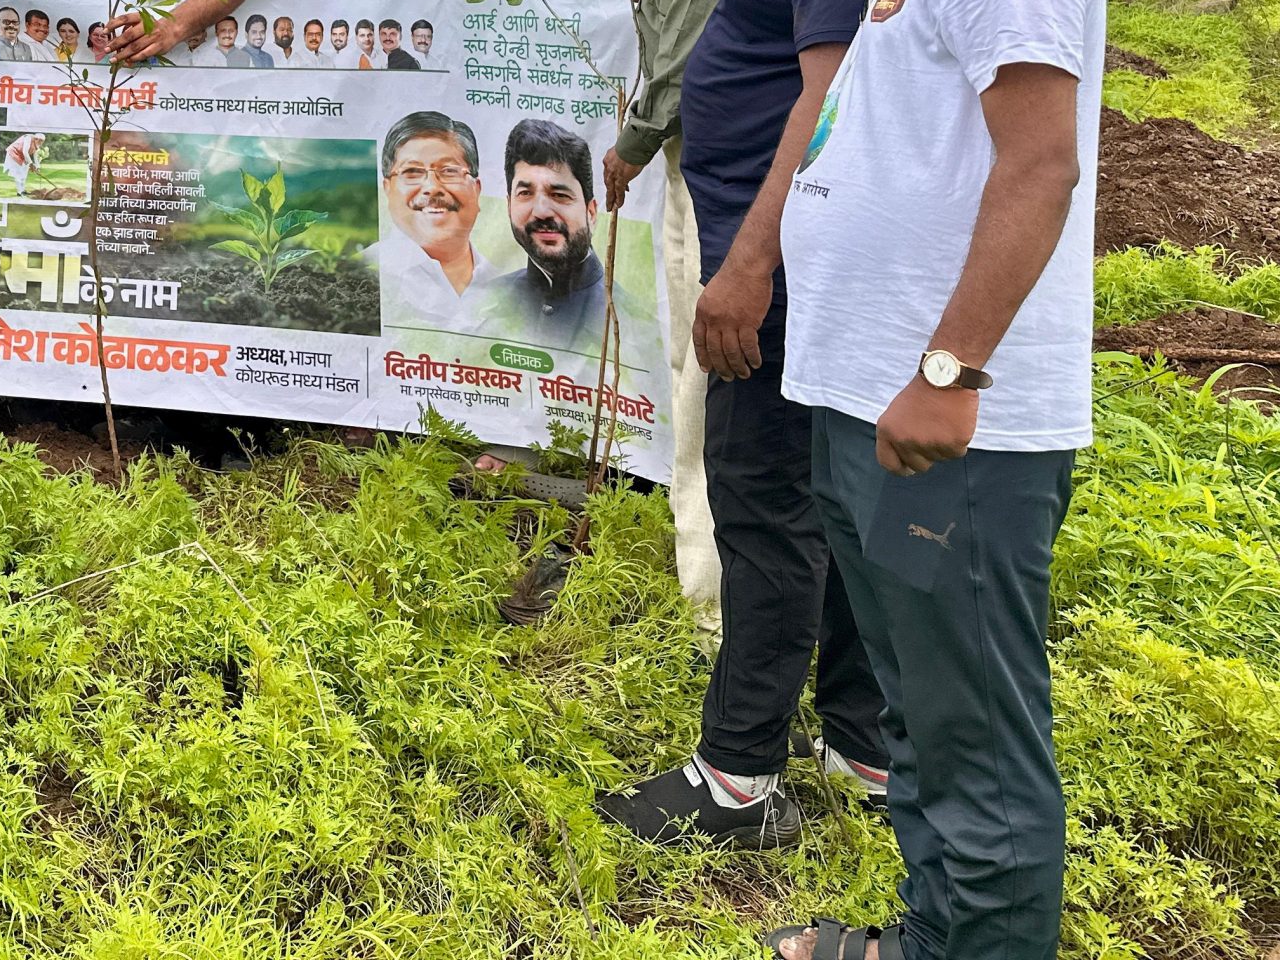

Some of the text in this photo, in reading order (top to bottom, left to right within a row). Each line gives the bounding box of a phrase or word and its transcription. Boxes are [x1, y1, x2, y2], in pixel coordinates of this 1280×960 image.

[463, 9, 498, 33] आई
[503, 9, 539, 33] आणि
[493, 34, 530, 59] दोन्ही
[527, 64, 574, 89] संवर्धन
[37, 85, 104, 109] जनता
[106, 81, 158, 110] पार्टी
[159, 93, 345, 117] कोथरूड मध्य मंडल आयोजित
[517, 93, 565, 114] लागवड
[132, 166, 150, 180] प्रेम,
[151, 170, 173, 182] माया,
[175, 169, 200, 182] आणि
[144, 182, 174, 196] पहिली
[174, 184, 207, 198] सावली.
[119, 196, 145, 210] तिच्या
[146, 198, 196, 213] आठवणींना
[96, 212, 113, 222] एक
[114, 211, 136, 224] हरित
[137, 214, 155, 225] रूप
[96, 226, 112, 237] एक
[113, 227, 134, 240] झाड
[96, 239, 120, 253] तिच्या
[3, 210, 90, 305] माँ
[78, 264, 115, 306] के
[119, 276, 183, 311] नाम
[235, 346, 332, 369] अध्यक्ष, भाजपा
[235, 364, 360, 394] कोथरूड मध्य मंडल
[384, 350, 523, 393] दिलीप उंबरकर
[414, 386, 463, 404] नगरसेवक,
[464, 390, 482, 407] पुणे
[484, 394, 510, 408] मनपा
[538, 375, 593, 407] सचिन
[544, 405, 587, 425] उपाध्यक्ष,
